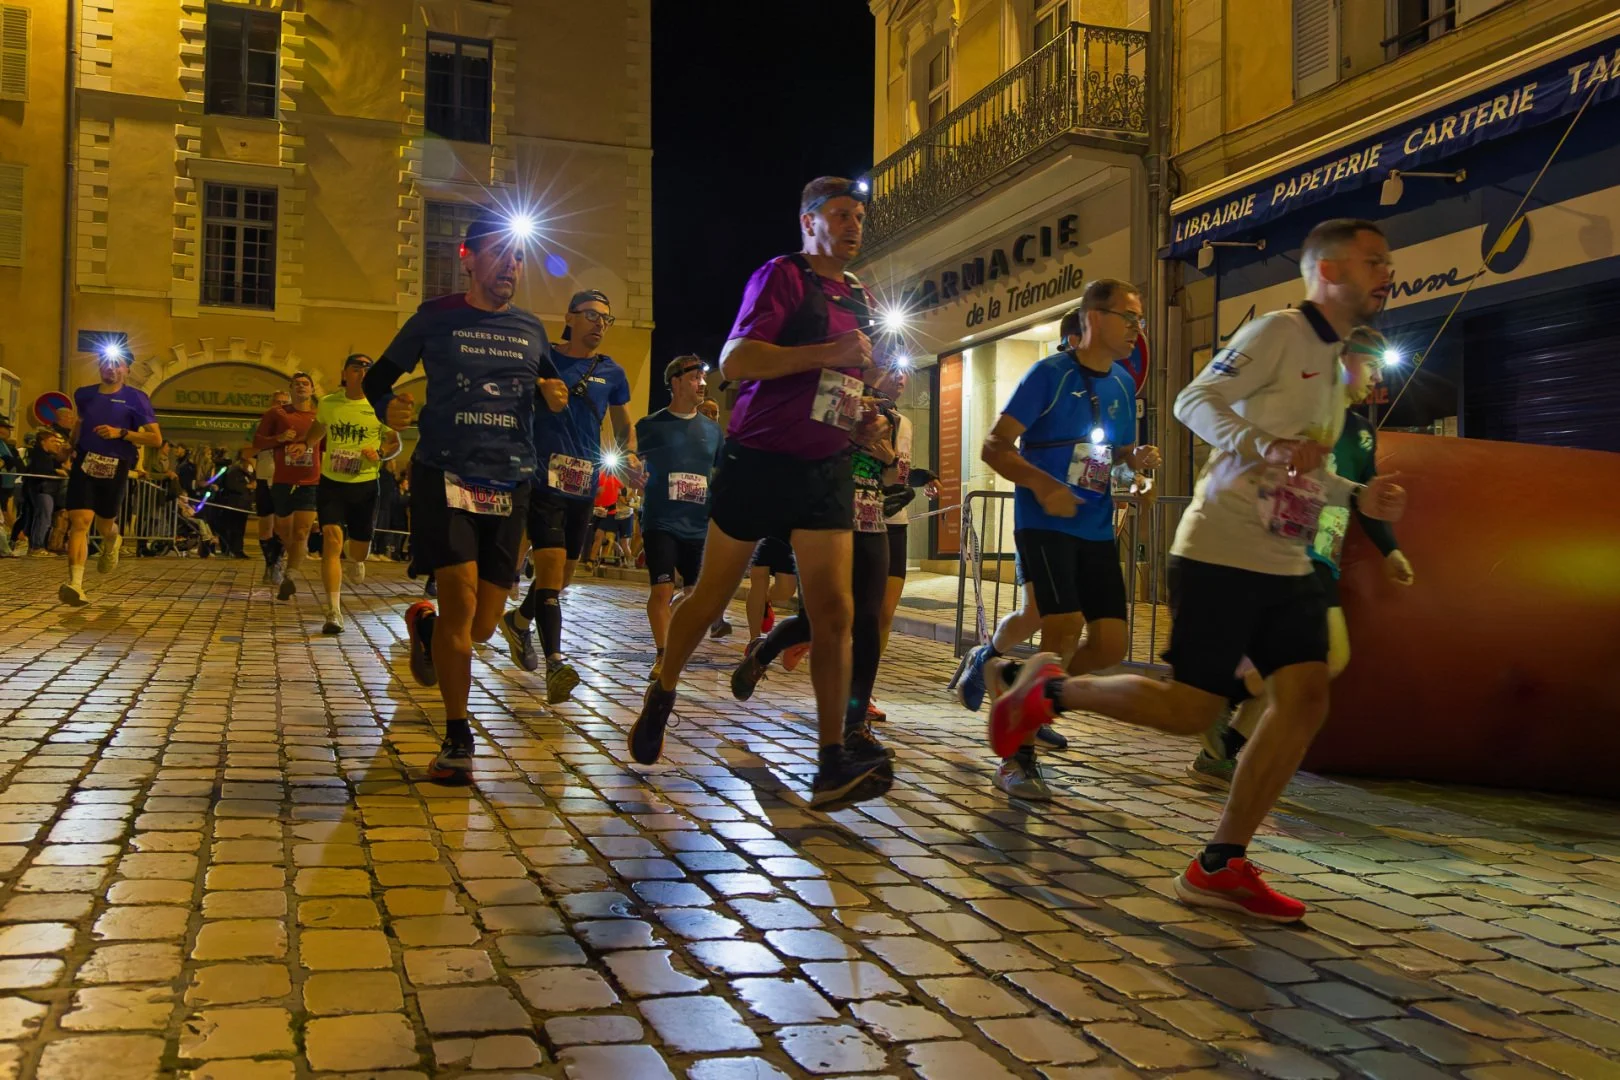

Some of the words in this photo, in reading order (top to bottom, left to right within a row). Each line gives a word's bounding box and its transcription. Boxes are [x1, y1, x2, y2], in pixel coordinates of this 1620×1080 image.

[1175, 193, 1257, 243] LIBRAIRIE
[1270, 143, 1383, 206] PAPETERIE
[1403, 82, 1538, 155] CARTERIE
[966, 303, 984, 328] de
[987, 297, 1001, 321] la
[1007, 264, 1083, 313] Trémoille
[493, 334, 506, 342] DU
[507, 336, 529, 346] TRAM
[488, 347, 524, 360] Nantes
[175, 390, 270, 408] BOULANGE
[209, 420, 240, 429] MAISON
[455, 411, 520, 430] FINISHER
